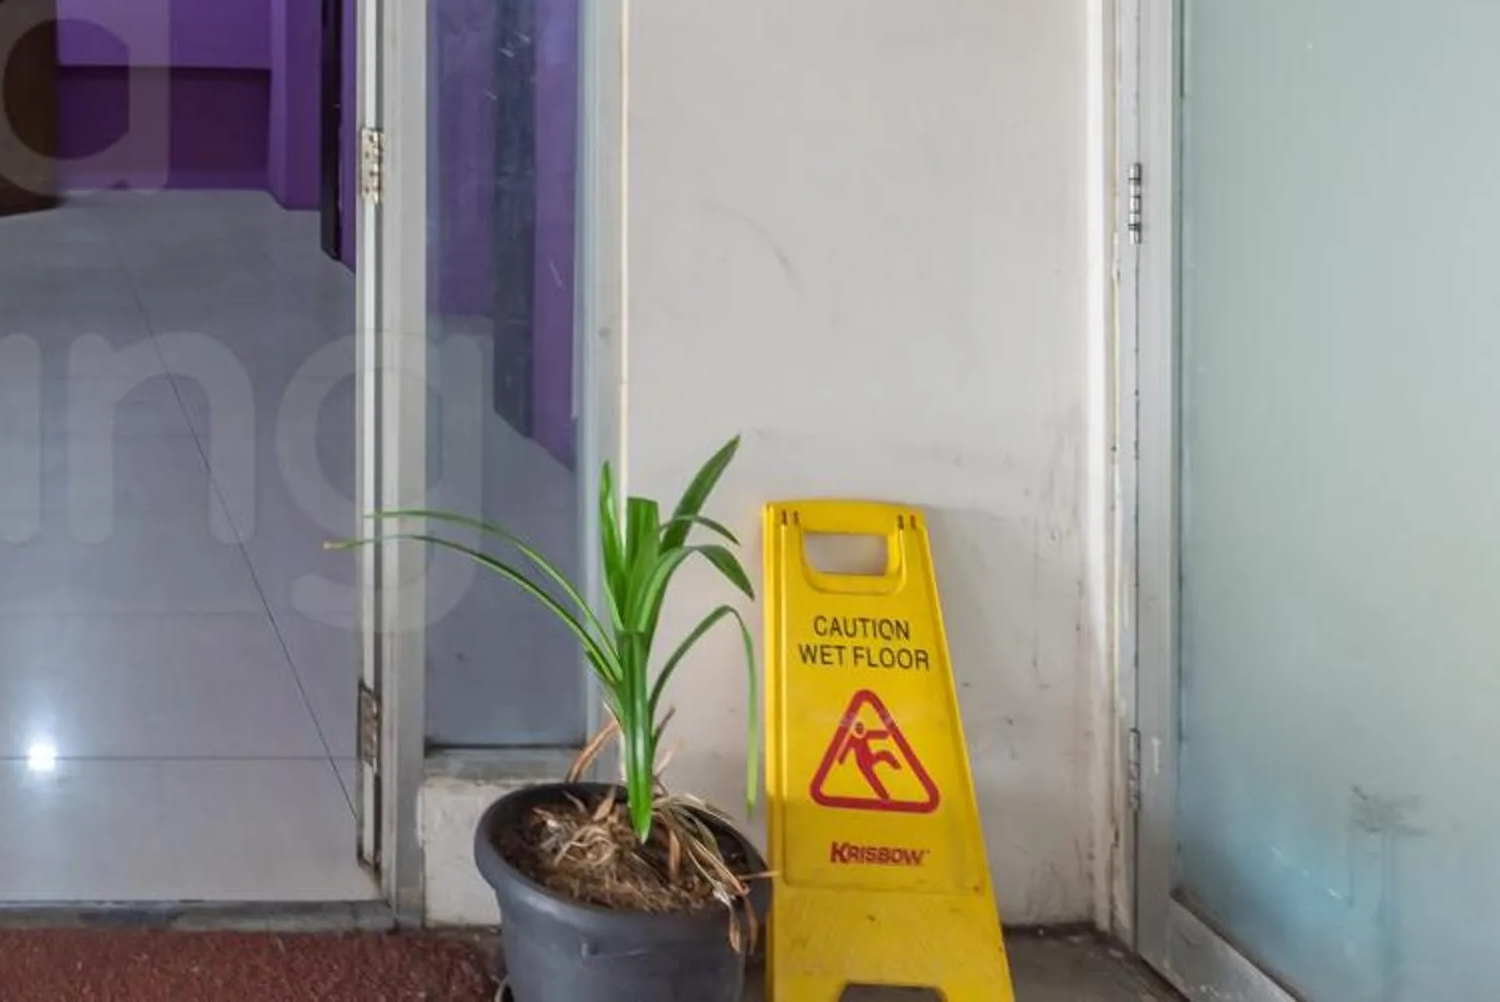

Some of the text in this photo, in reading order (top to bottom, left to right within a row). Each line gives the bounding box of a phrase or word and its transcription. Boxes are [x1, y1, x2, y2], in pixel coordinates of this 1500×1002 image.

[812, 614, 912, 641] CAUTION
[798, 643, 931, 671] WET FLOOR
[829, 841, 925, 867] KRISBOW
